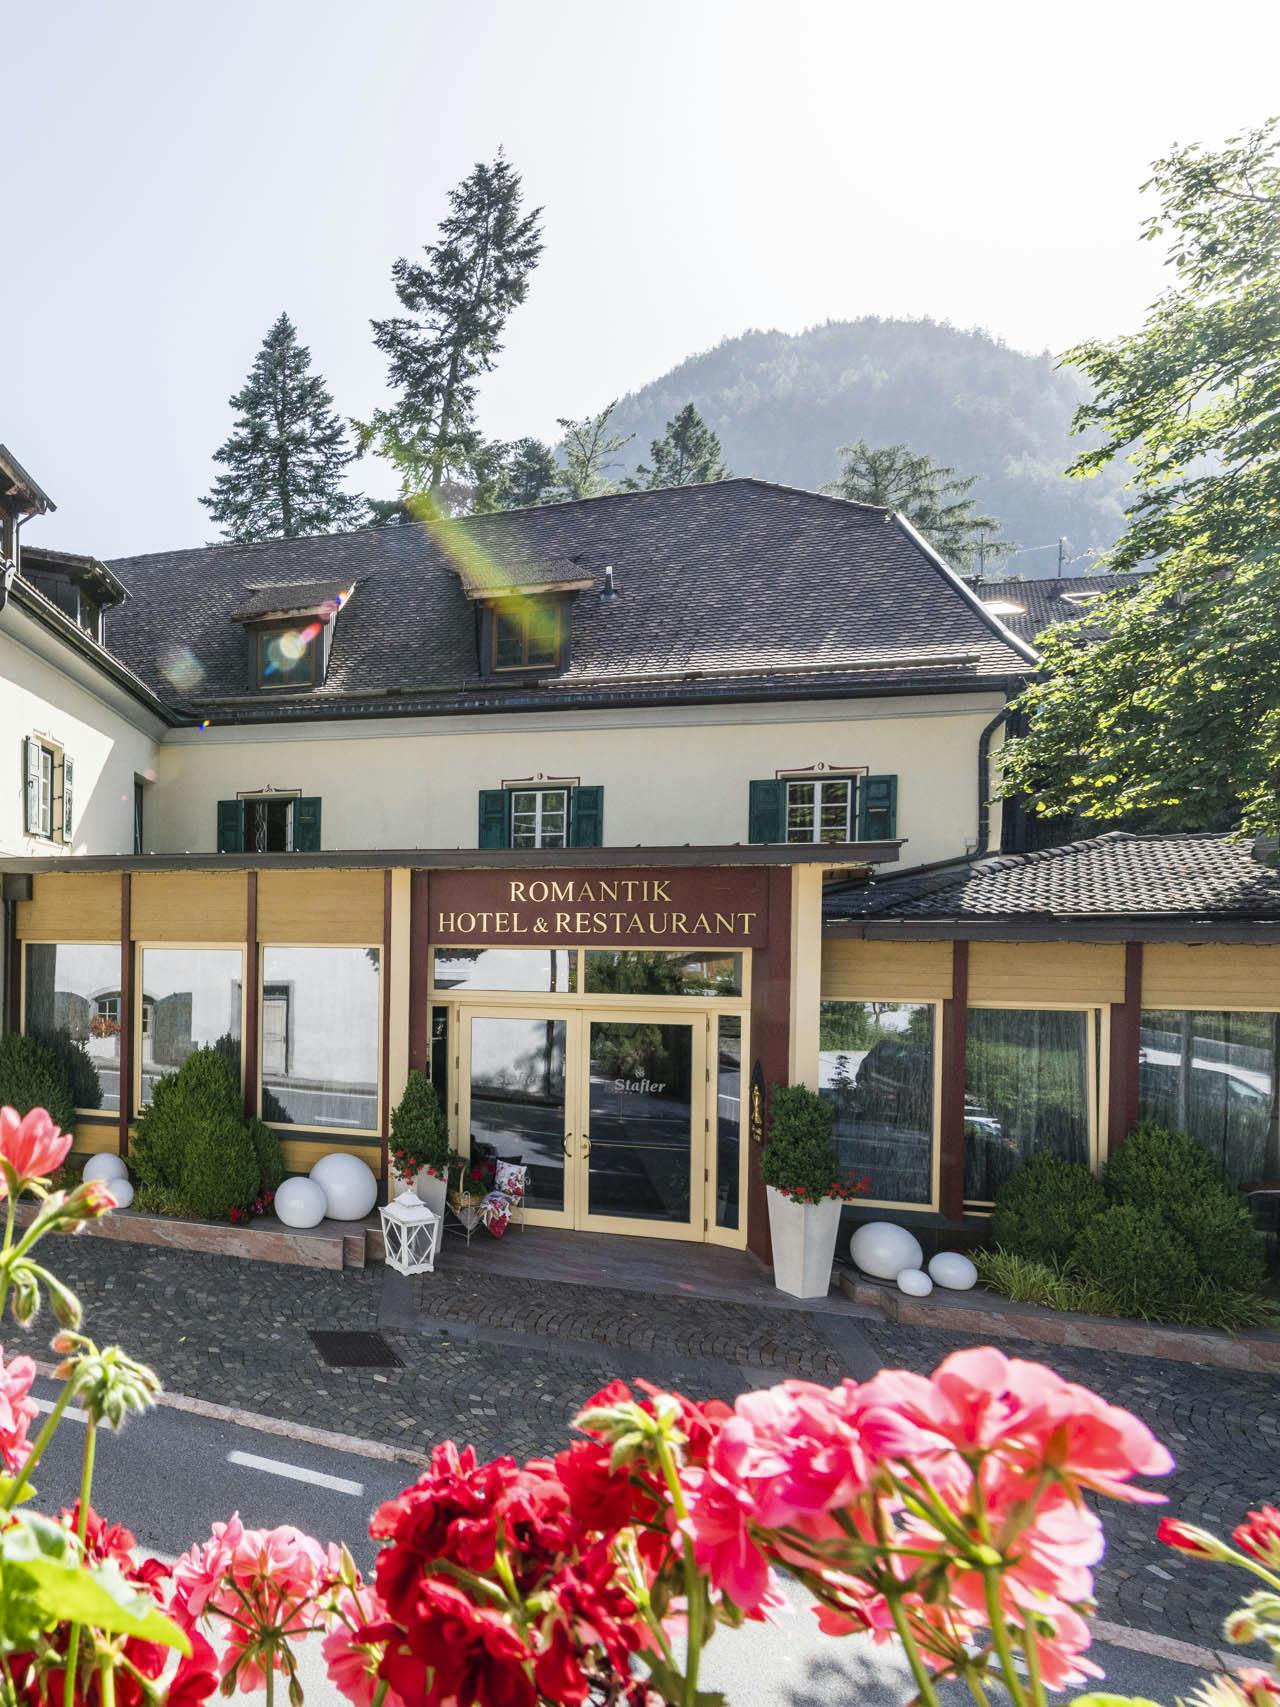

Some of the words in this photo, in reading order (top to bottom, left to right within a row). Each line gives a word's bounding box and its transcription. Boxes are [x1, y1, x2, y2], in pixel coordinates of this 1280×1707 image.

[509, 879, 673, 903] ROMANTIK
[438, 911, 529, 933] HOTEL
[532, 916, 550, 934] &
[555, 911, 758, 935] RESTAURANT
[614, 1078, 666, 1094] Stafler
